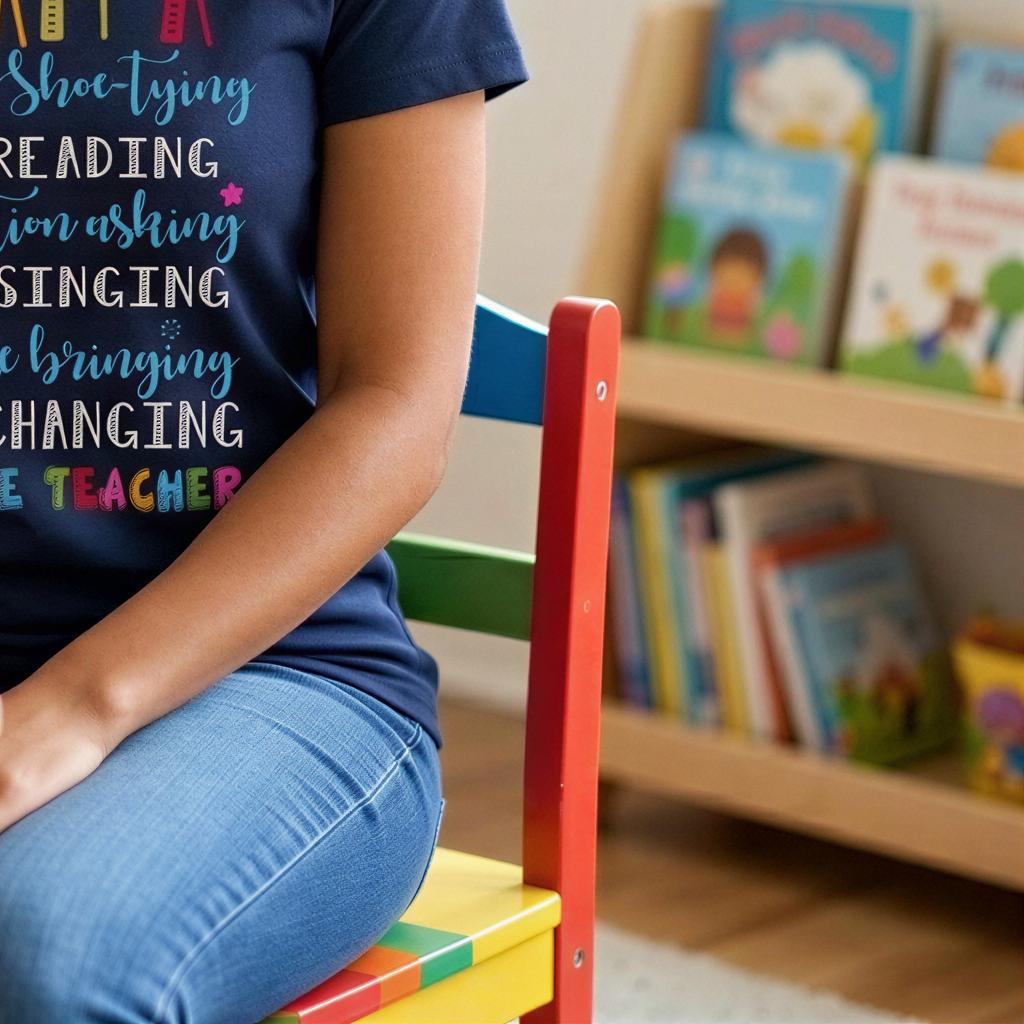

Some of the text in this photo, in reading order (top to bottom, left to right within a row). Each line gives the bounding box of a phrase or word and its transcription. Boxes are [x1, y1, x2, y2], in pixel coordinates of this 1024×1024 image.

[85, 189, 245, 263] asking
[30, 324, 240, 400] bringing
[44, 465, 242, 512] TEACHER
